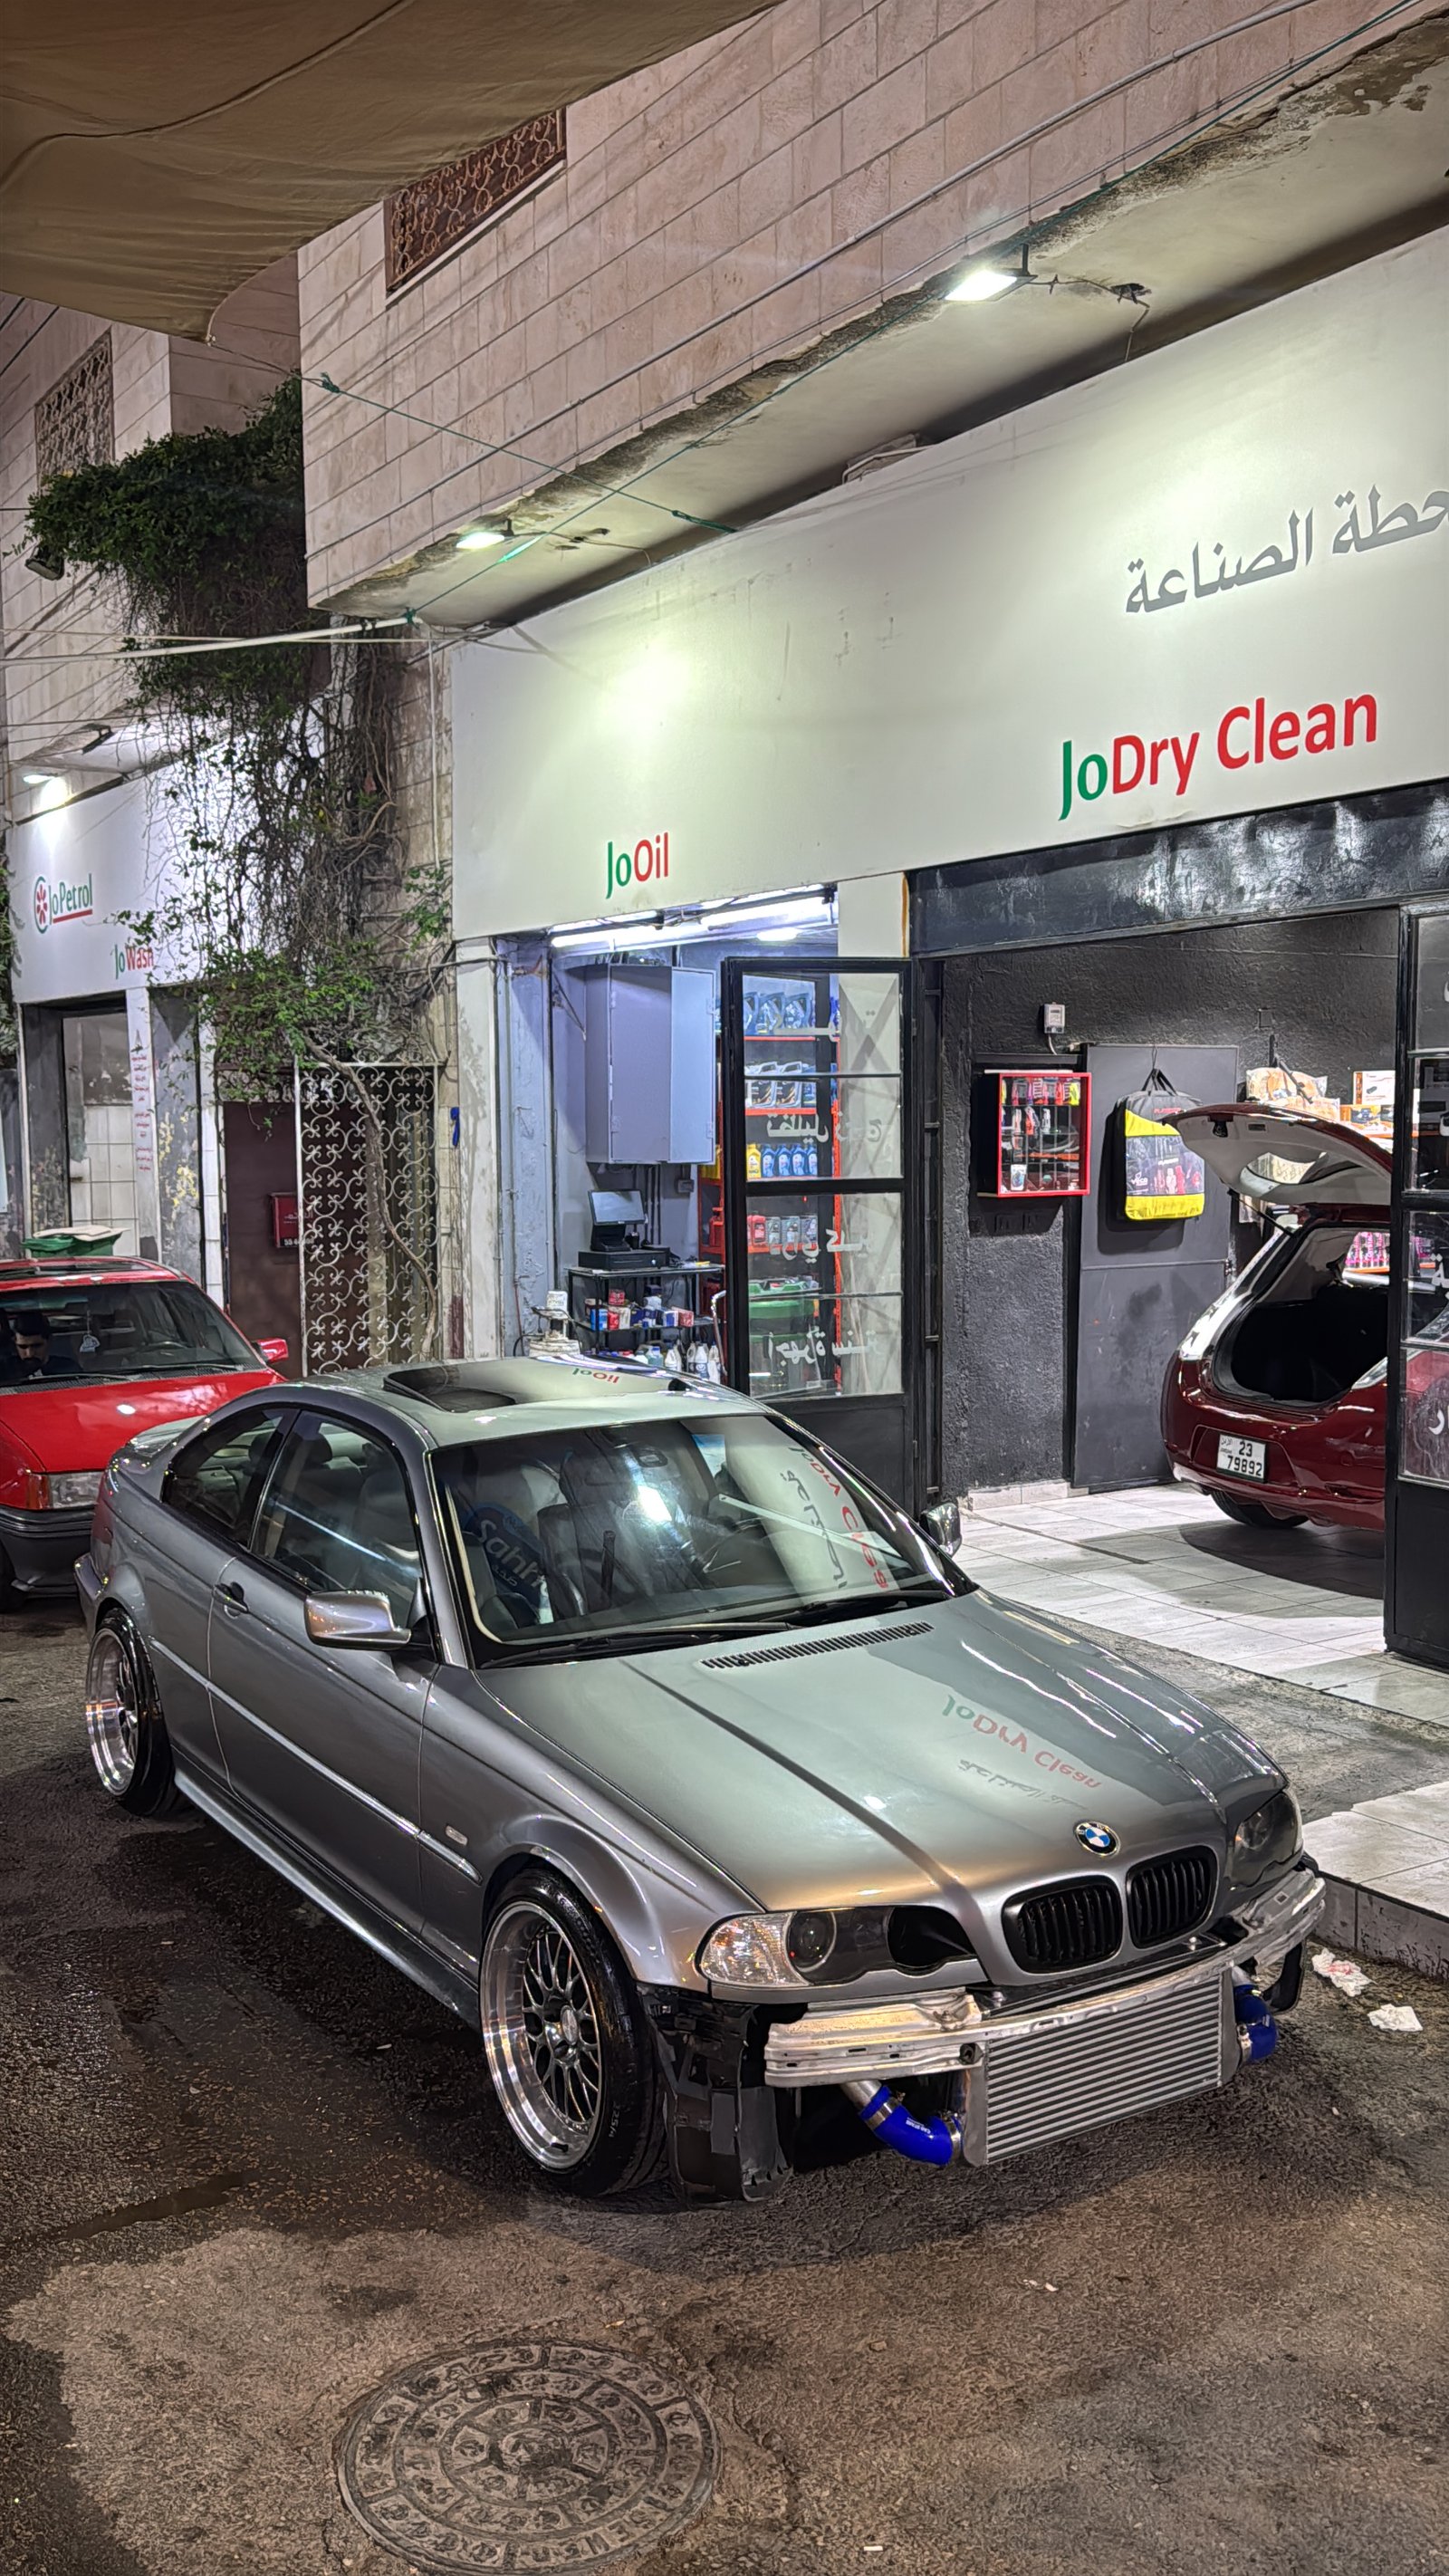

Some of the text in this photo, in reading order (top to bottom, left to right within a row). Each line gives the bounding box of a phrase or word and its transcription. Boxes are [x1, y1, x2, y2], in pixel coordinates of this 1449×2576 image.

[1125, 483, 1449, 613] حطة الصناعة
[1059, 693, 1377, 822] JoDry Clean
[605, 831, 668, 900] JoOil
[1226, 1455, 1262, 1476] 79892
[1238, 1440, 1252, 1457] 23
